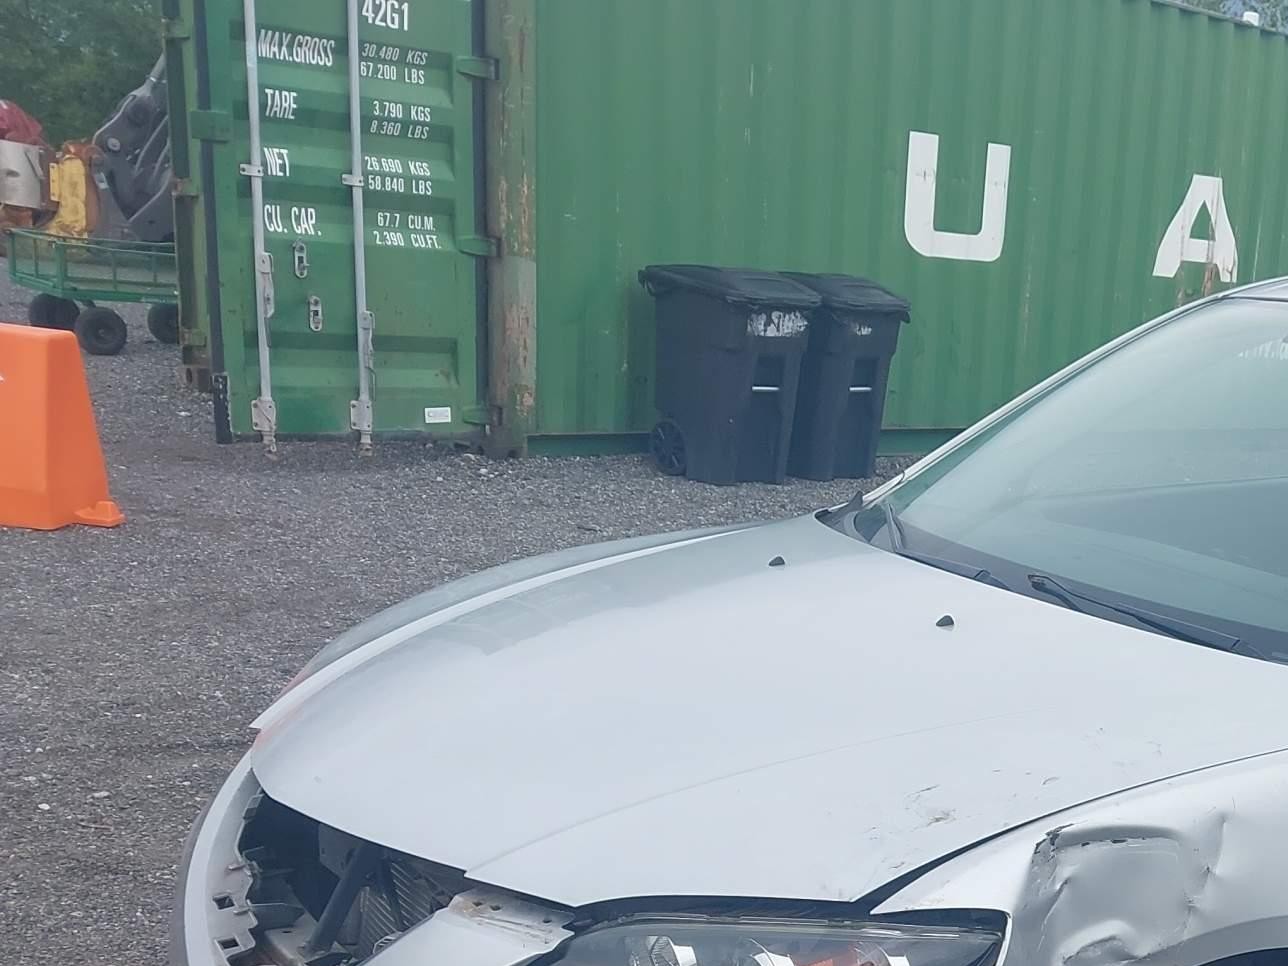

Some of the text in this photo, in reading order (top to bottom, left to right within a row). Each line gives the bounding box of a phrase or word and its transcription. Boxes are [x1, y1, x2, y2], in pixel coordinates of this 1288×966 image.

[361, 0, 408, 31] 42G1
[258, 29, 335, 67] MAX.GROSS
[361, 43, 428, 65] 30.480 KGS
[360, 61, 425, 84] 67.200 LBS
[264, 88, 298, 119] TARE
[372, 100, 431, 121] 3.790 KGS
[370, 119, 429, 139] 8.360 LBS
[263, 147, 290, 177] NET
[364, 156, 431, 176] 26.690 KGS
[368, 175, 432, 195] 58.840 LBS
[264, 204, 322, 236] CU. CAP.
[377, 212, 400, 228] 67.7
[373, 231, 404, 246] 2.390
